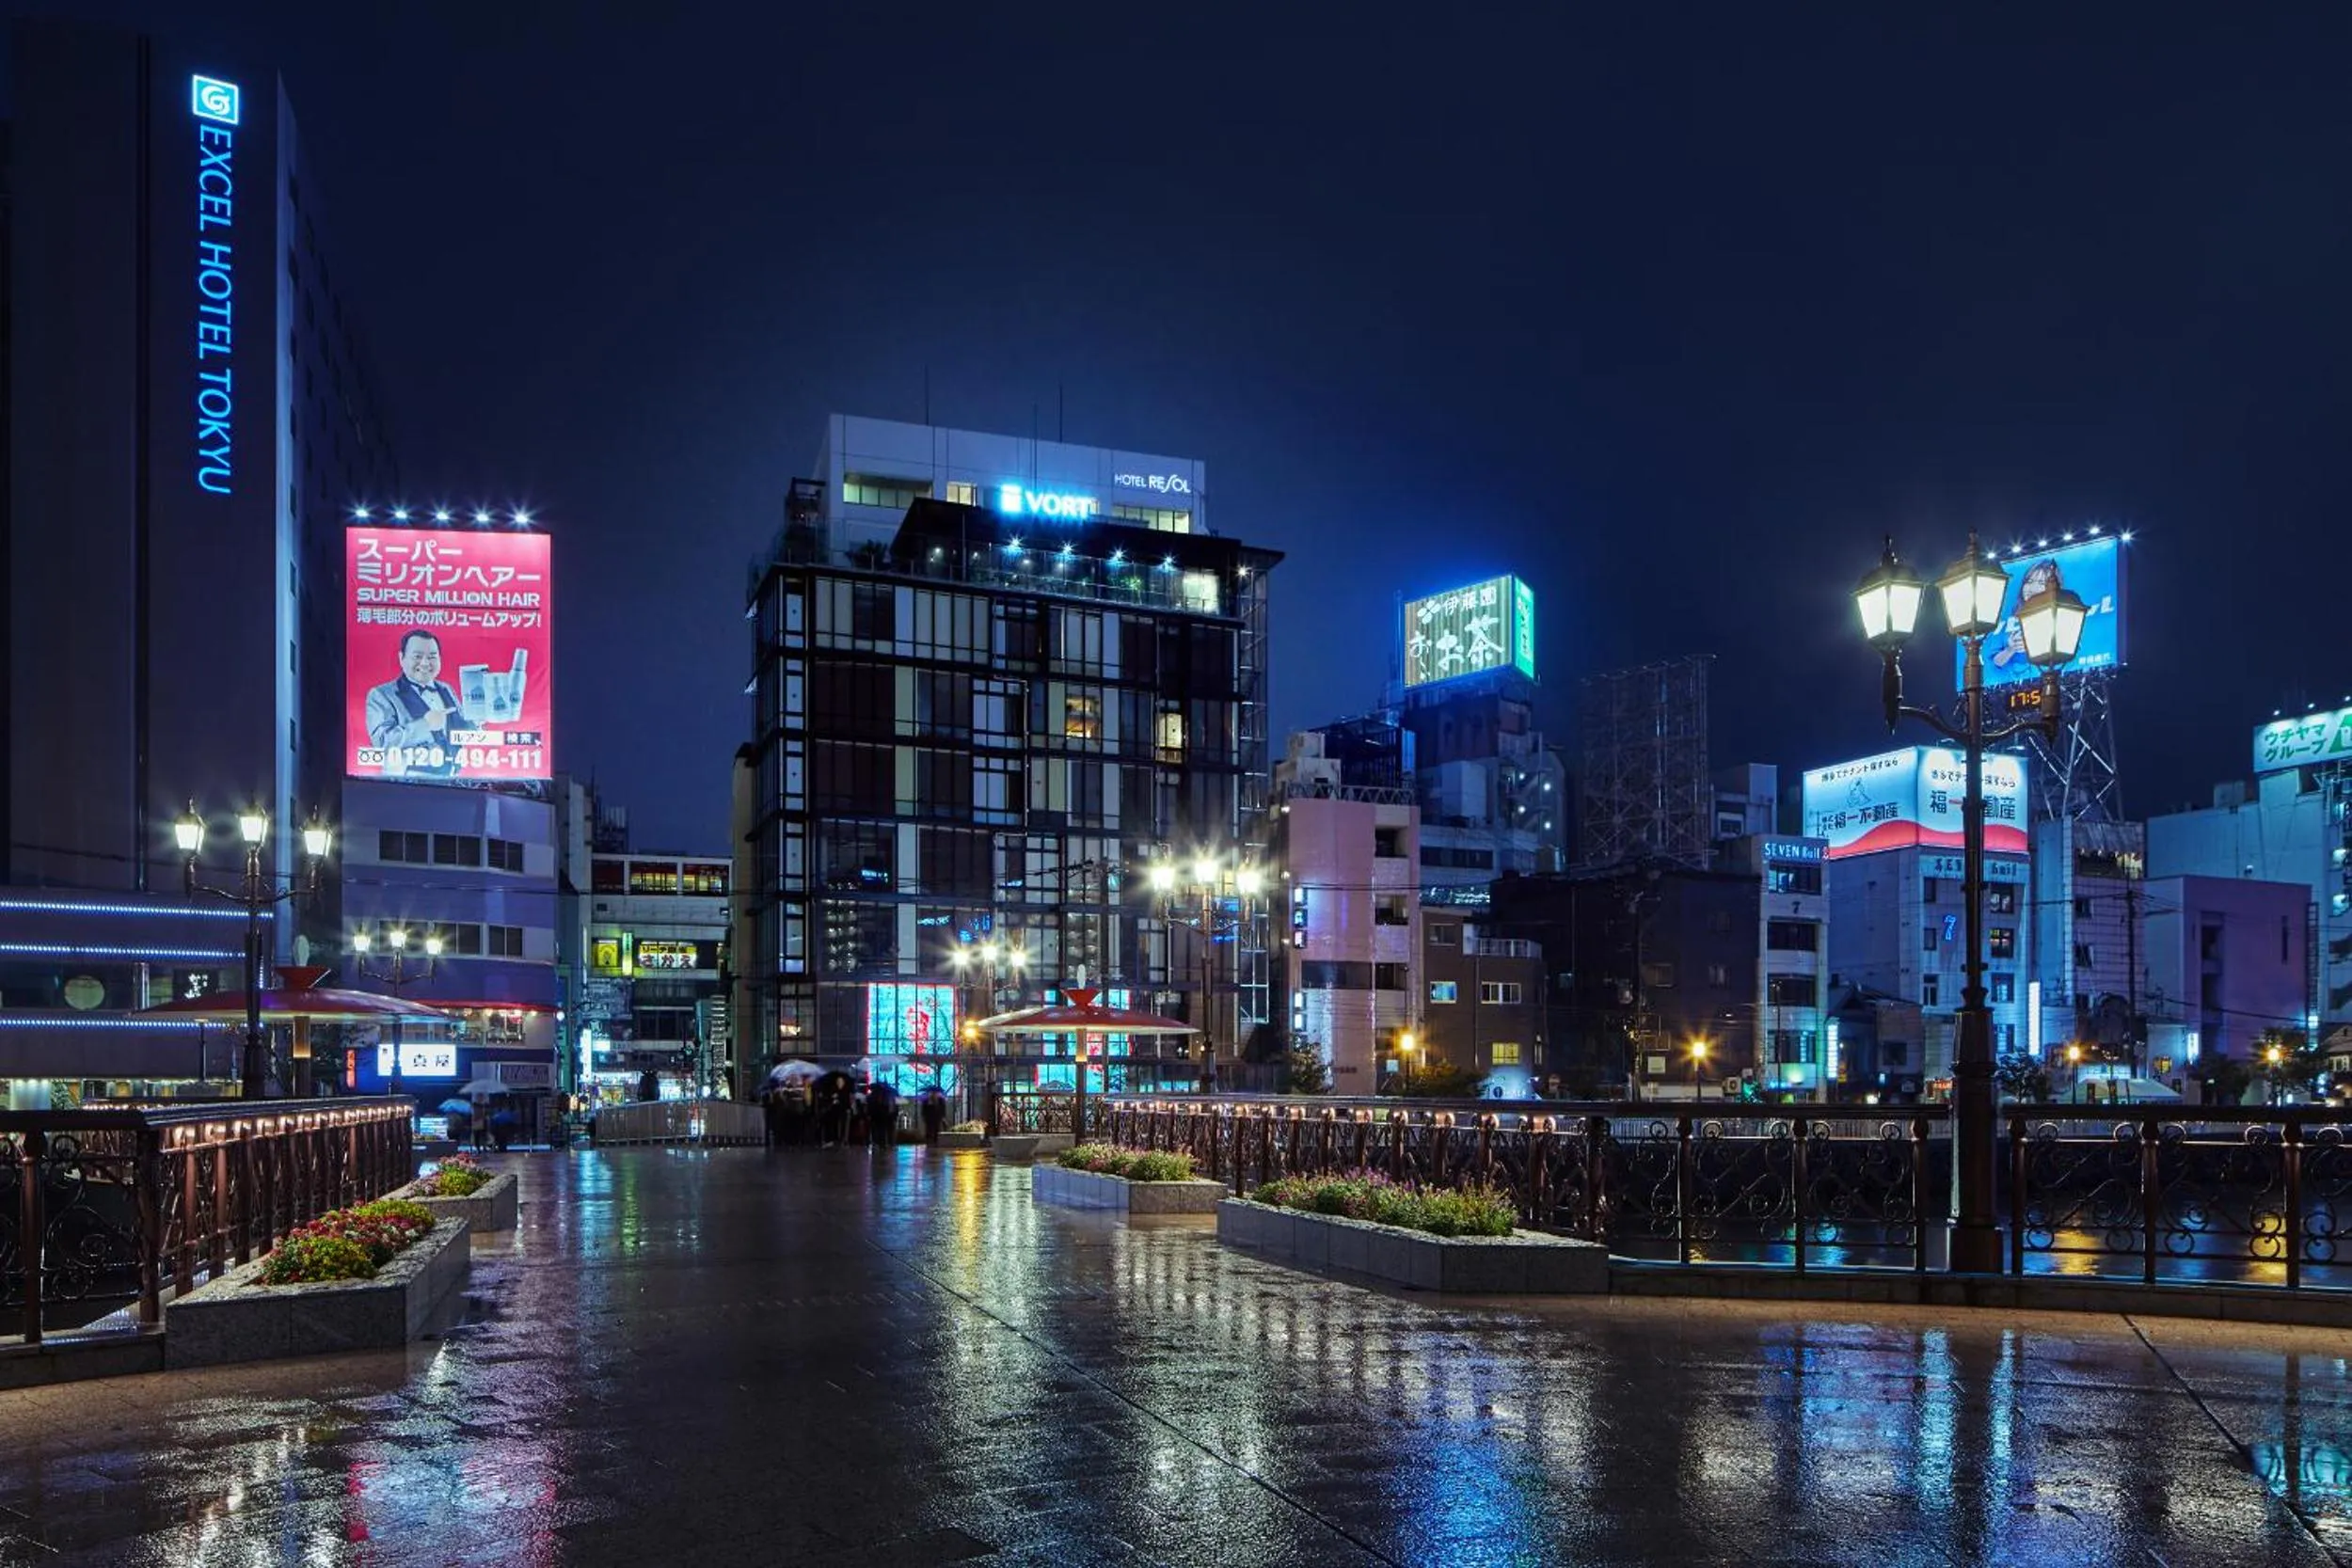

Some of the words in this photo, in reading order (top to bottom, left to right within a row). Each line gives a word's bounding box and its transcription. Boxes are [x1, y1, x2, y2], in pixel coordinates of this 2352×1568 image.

[199, 123, 231, 231] EXCEL
[198, 240, 231, 360] HOTEL
[198, 369, 231, 494] TOKYU
[1114, 473, 1147, 488] HOTEL
[1149, 473, 1192, 494] RESOL
[1025, 490, 1094, 519] VORT
[357, 537, 463, 562] スーパー
[357, 562, 541, 588] ミリオンヘアー
[357, 587, 420, 603] SUPER
[425, 590, 493, 606] MILLION
[498, 592, 541, 607] HAIR
[2010, 689, 2042, 707] 17:5
[2264, 723, 2326, 746] ウチヤマ
[2264, 737, 2328, 764] グループ
[1930, 789, 2016, 821] 福一動産
[1764, 842, 1800, 858] SEVEN
